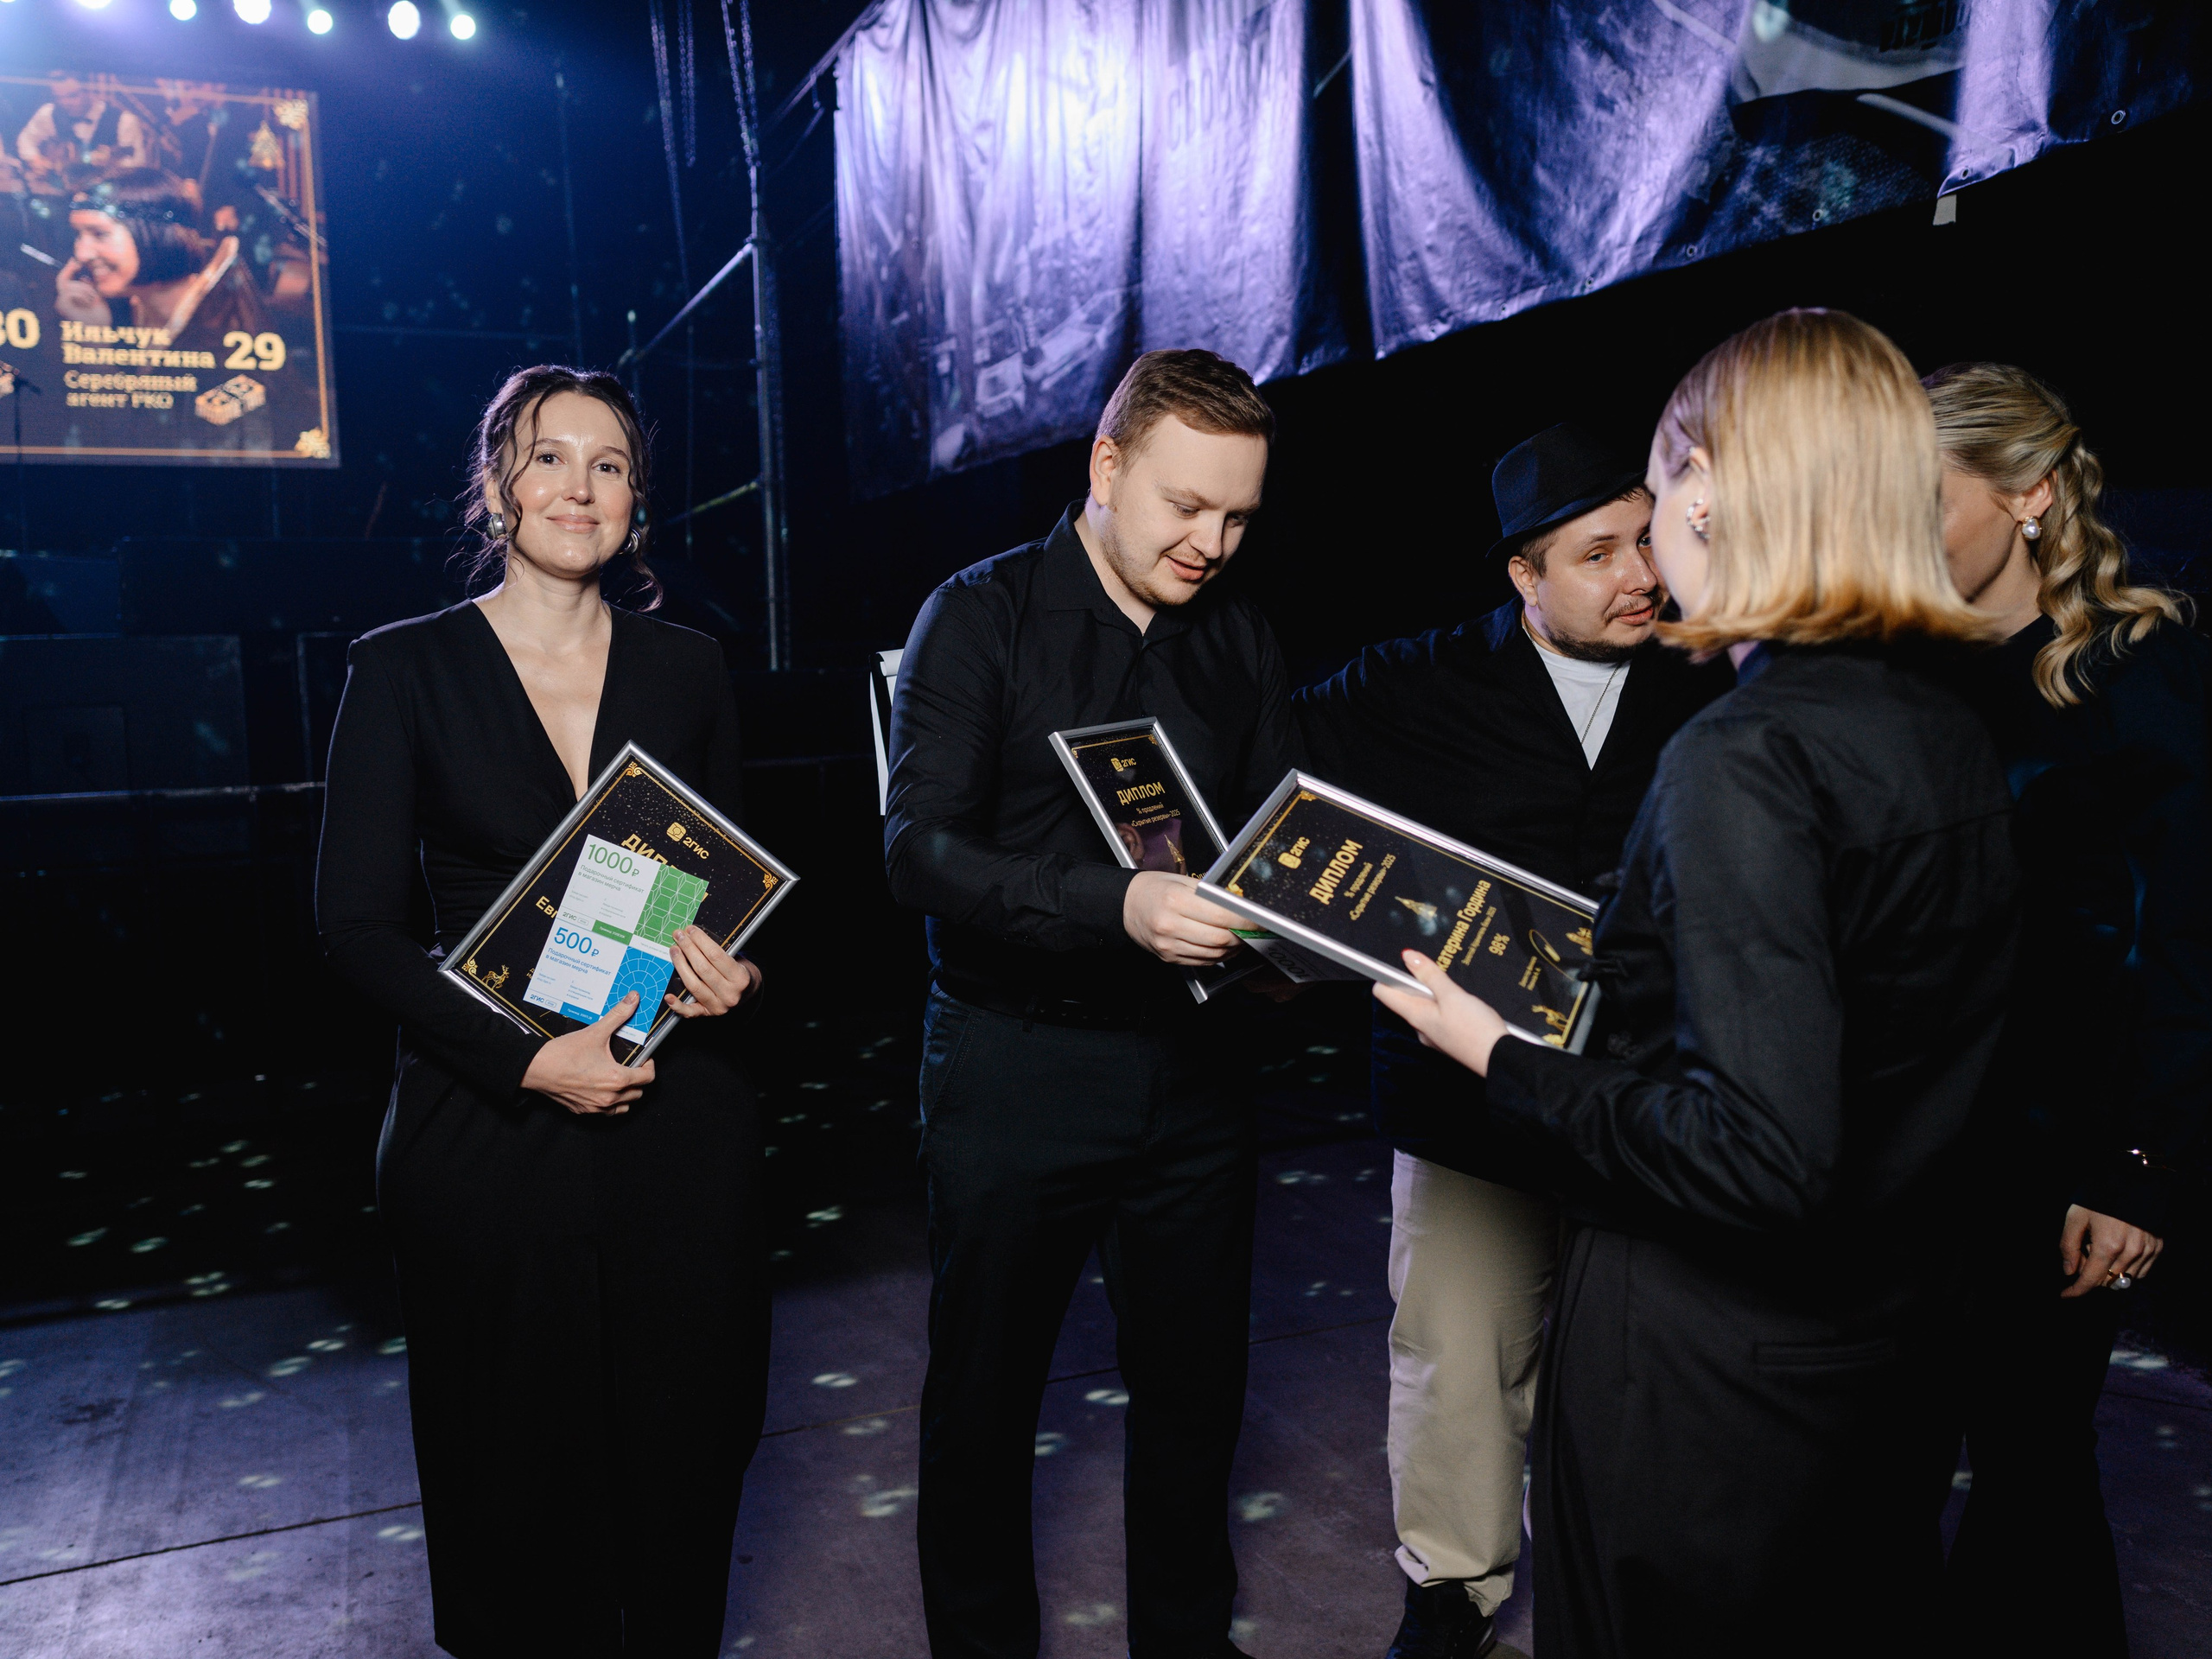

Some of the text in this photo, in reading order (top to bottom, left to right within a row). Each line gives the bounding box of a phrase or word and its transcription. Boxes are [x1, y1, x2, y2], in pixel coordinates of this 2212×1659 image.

[0, 308, 41, 349] 0
[60, 321, 172, 348] Ильчук
[62, 342, 216, 369] Валентина
[223, 331, 286, 371] 29
[64, 370, 198, 392] Серебряный
[1122, 757, 1137, 767] 2ГИС
[1116, 781, 1166, 805] ДИПЛОМ
[683, 836, 709, 860] 2ГИС
[1289, 836, 1311, 856] 2ГИС
[580, 864, 645, 893] Подарочный сертификат
[582, 873, 606, 886] магазин
[604, 881, 621, 892] мерча
[1308, 838, 1363, 906] ДИПЛОМ
[563, 912, 577, 921] 2ГИС
[1434, 880, 1491, 972] катерина Гордина
[1488, 932, 1510, 956] 98%
[548, 947, 612, 976] Подарочный сертификат
[549, 955, 572, 968] магазин
[571, 964, 588, 974] мерча
[530, 994, 545, 1003] 2ГИС
